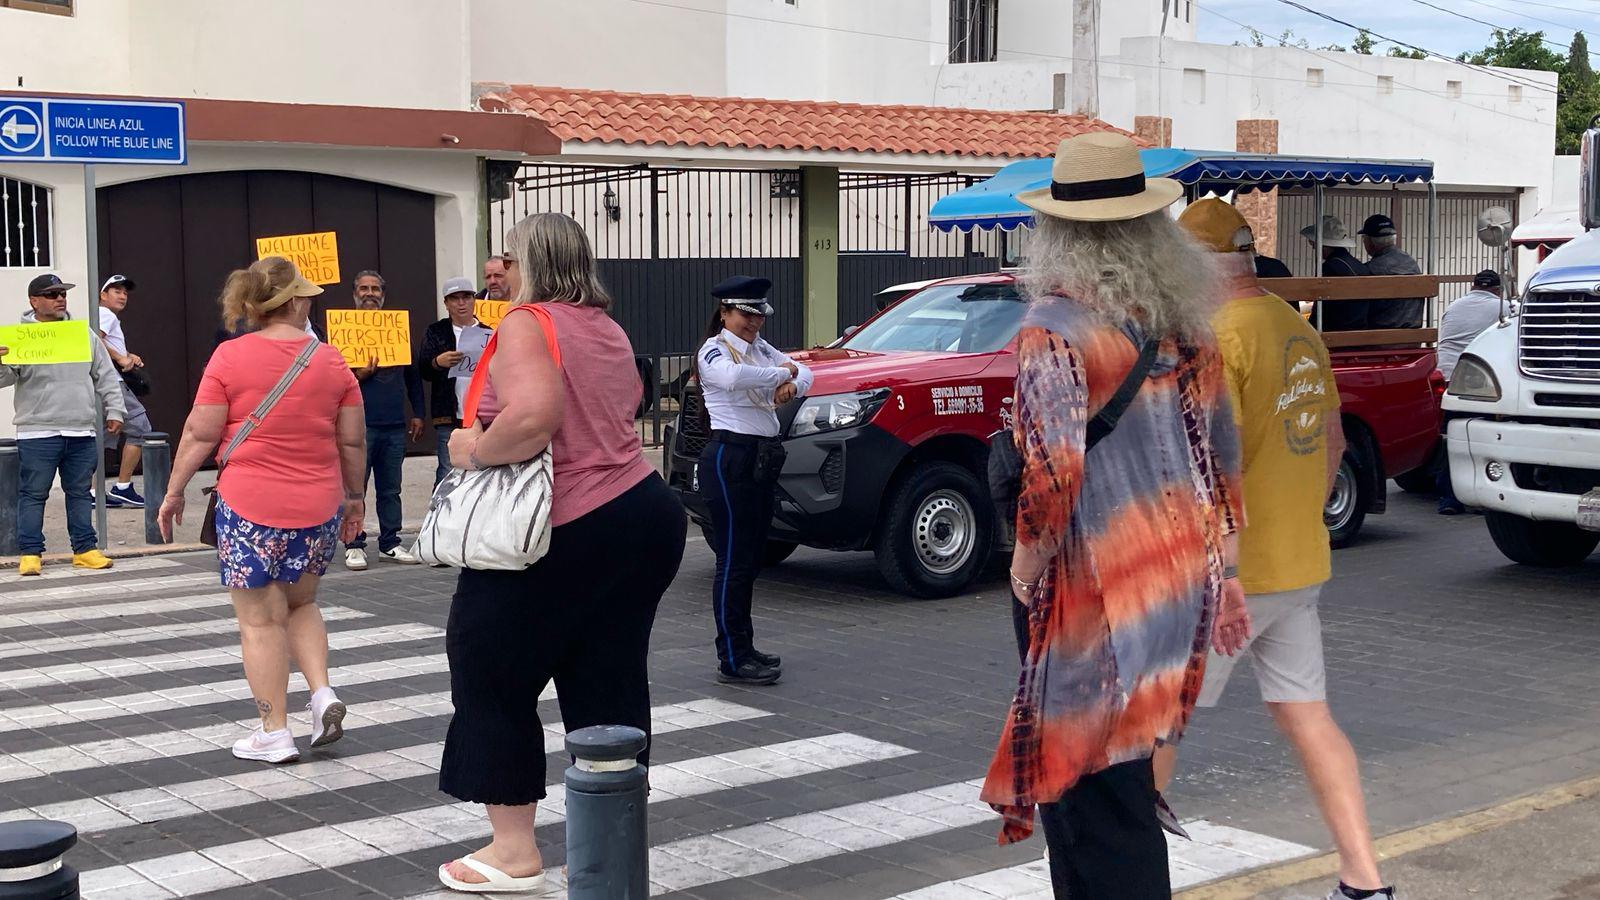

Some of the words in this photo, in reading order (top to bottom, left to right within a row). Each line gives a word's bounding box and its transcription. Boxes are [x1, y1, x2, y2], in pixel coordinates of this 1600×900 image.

[55, 116, 85, 129] INICIA
[87, 117, 116, 130] LINEA
[119, 118, 144, 131] AZUL
[55, 134, 98, 148] FOLLOW
[100, 136, 121, 148] THE
[123, 137, 149, 149] BLUE
[152, 138, 174, 149] LINE
[258, 234, 331, 255] WELCOME
[814, 239, 831, 250] 413
[300, 267, 334, 282] AID
[329, 311, 404, 329] WELCOME
[330, 328, 409, 346] KIERSTEN
[340, 346, 396, 364] SMITH
[896, 394, 905, 411] 3
